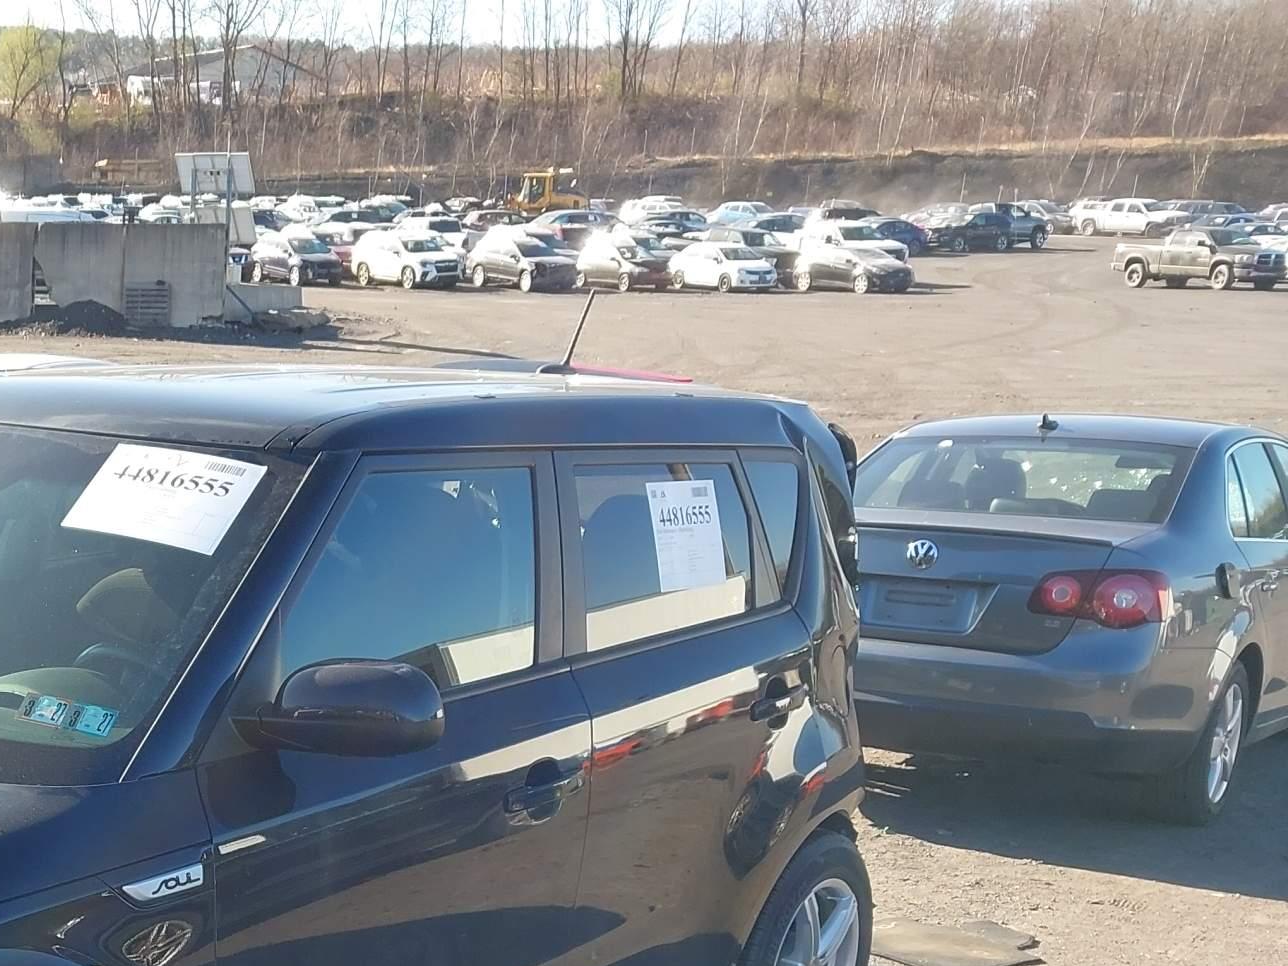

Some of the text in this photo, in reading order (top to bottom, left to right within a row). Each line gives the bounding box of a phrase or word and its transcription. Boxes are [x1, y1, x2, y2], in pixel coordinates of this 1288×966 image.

[114, 465, 235, 497] 44816555
[659, 504, 712, 527] 44816555
[50, 702, 68, 724] 27
[97, 712, 114, 734] 27
